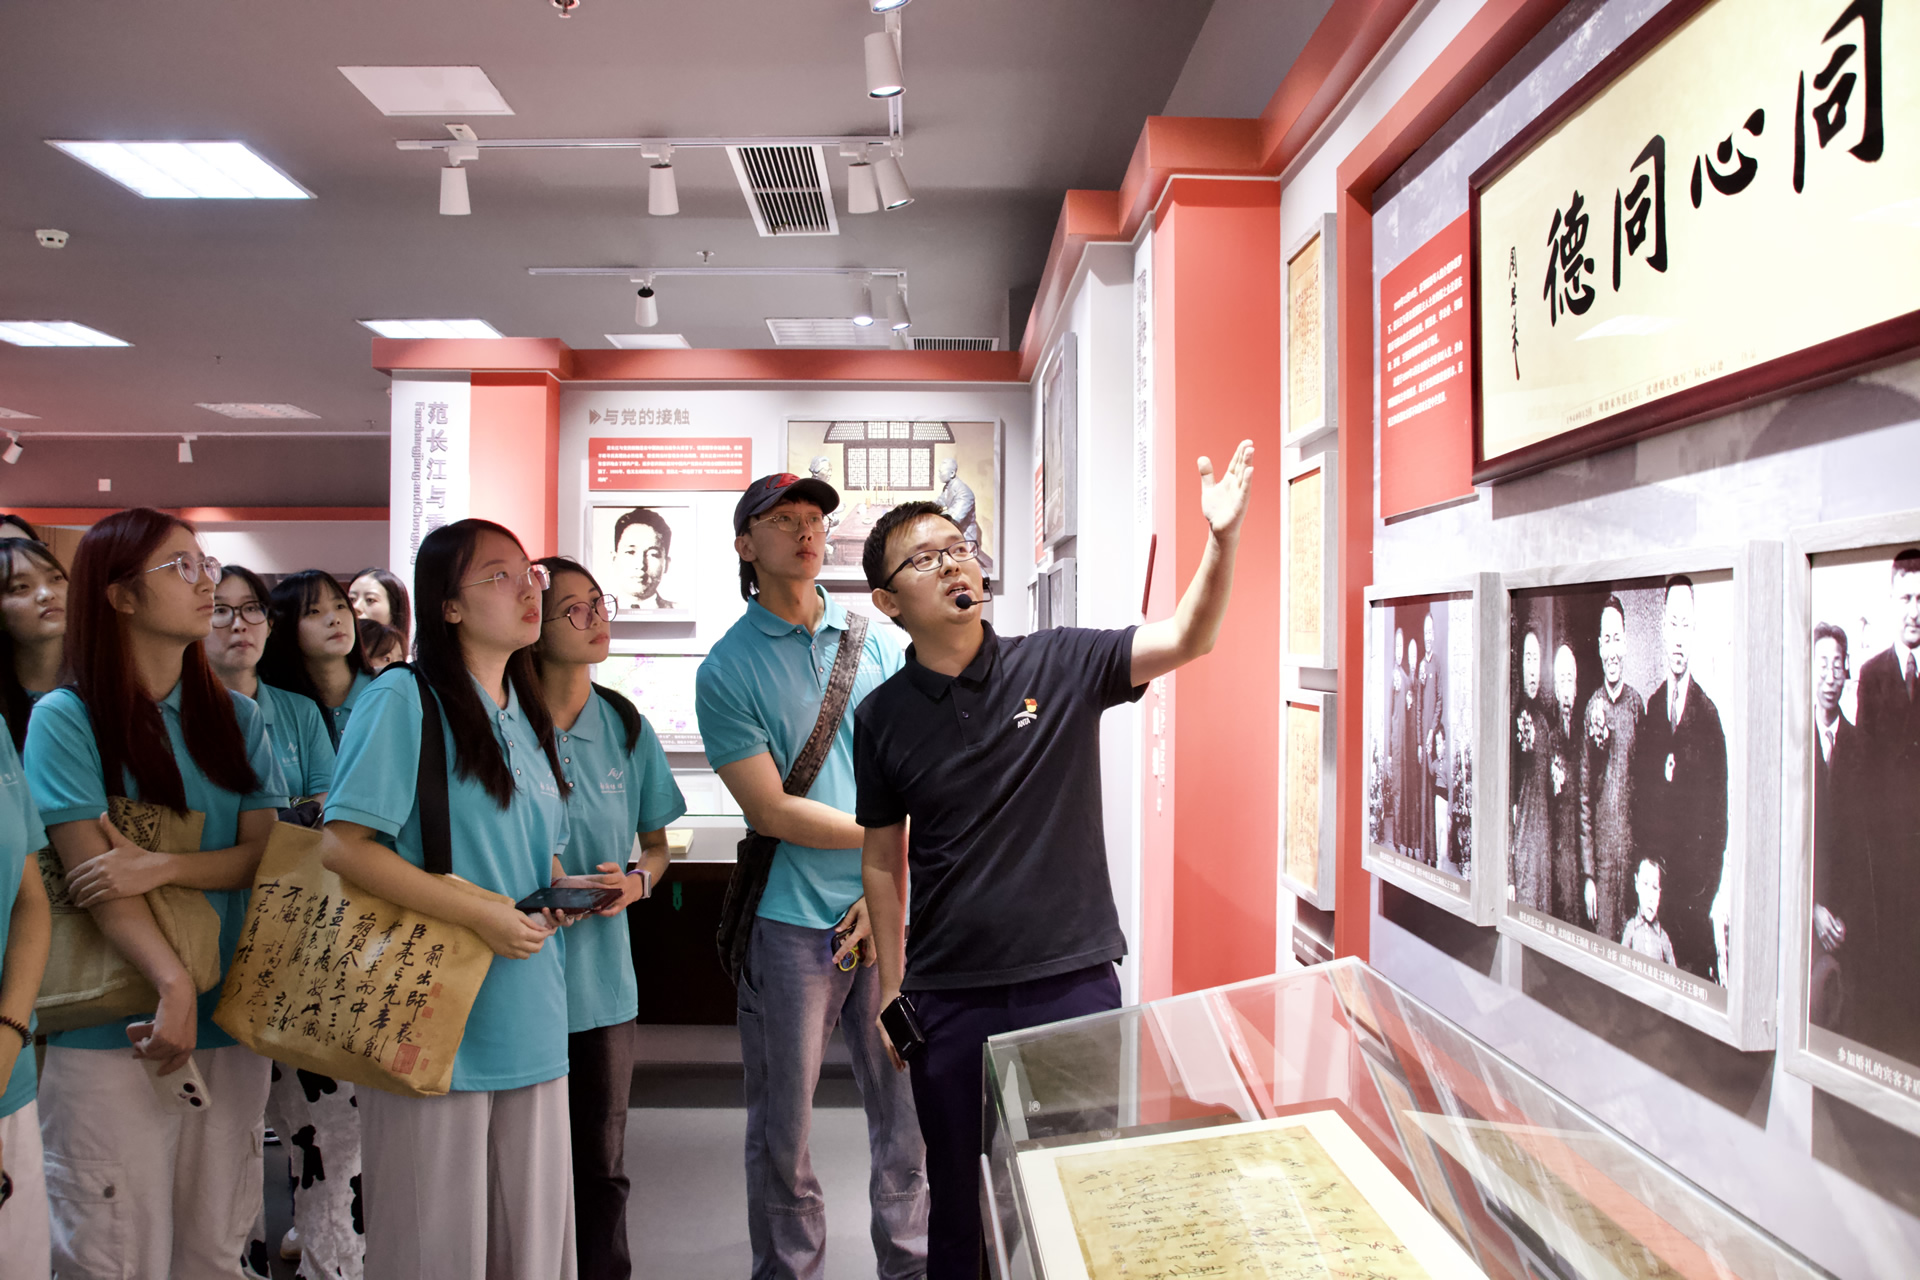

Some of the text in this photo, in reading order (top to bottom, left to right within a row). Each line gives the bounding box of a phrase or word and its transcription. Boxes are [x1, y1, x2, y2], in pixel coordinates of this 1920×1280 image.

[603, 408, 690, 425] 与党的接触
[1017, 717, 1031, 729] ANTA
